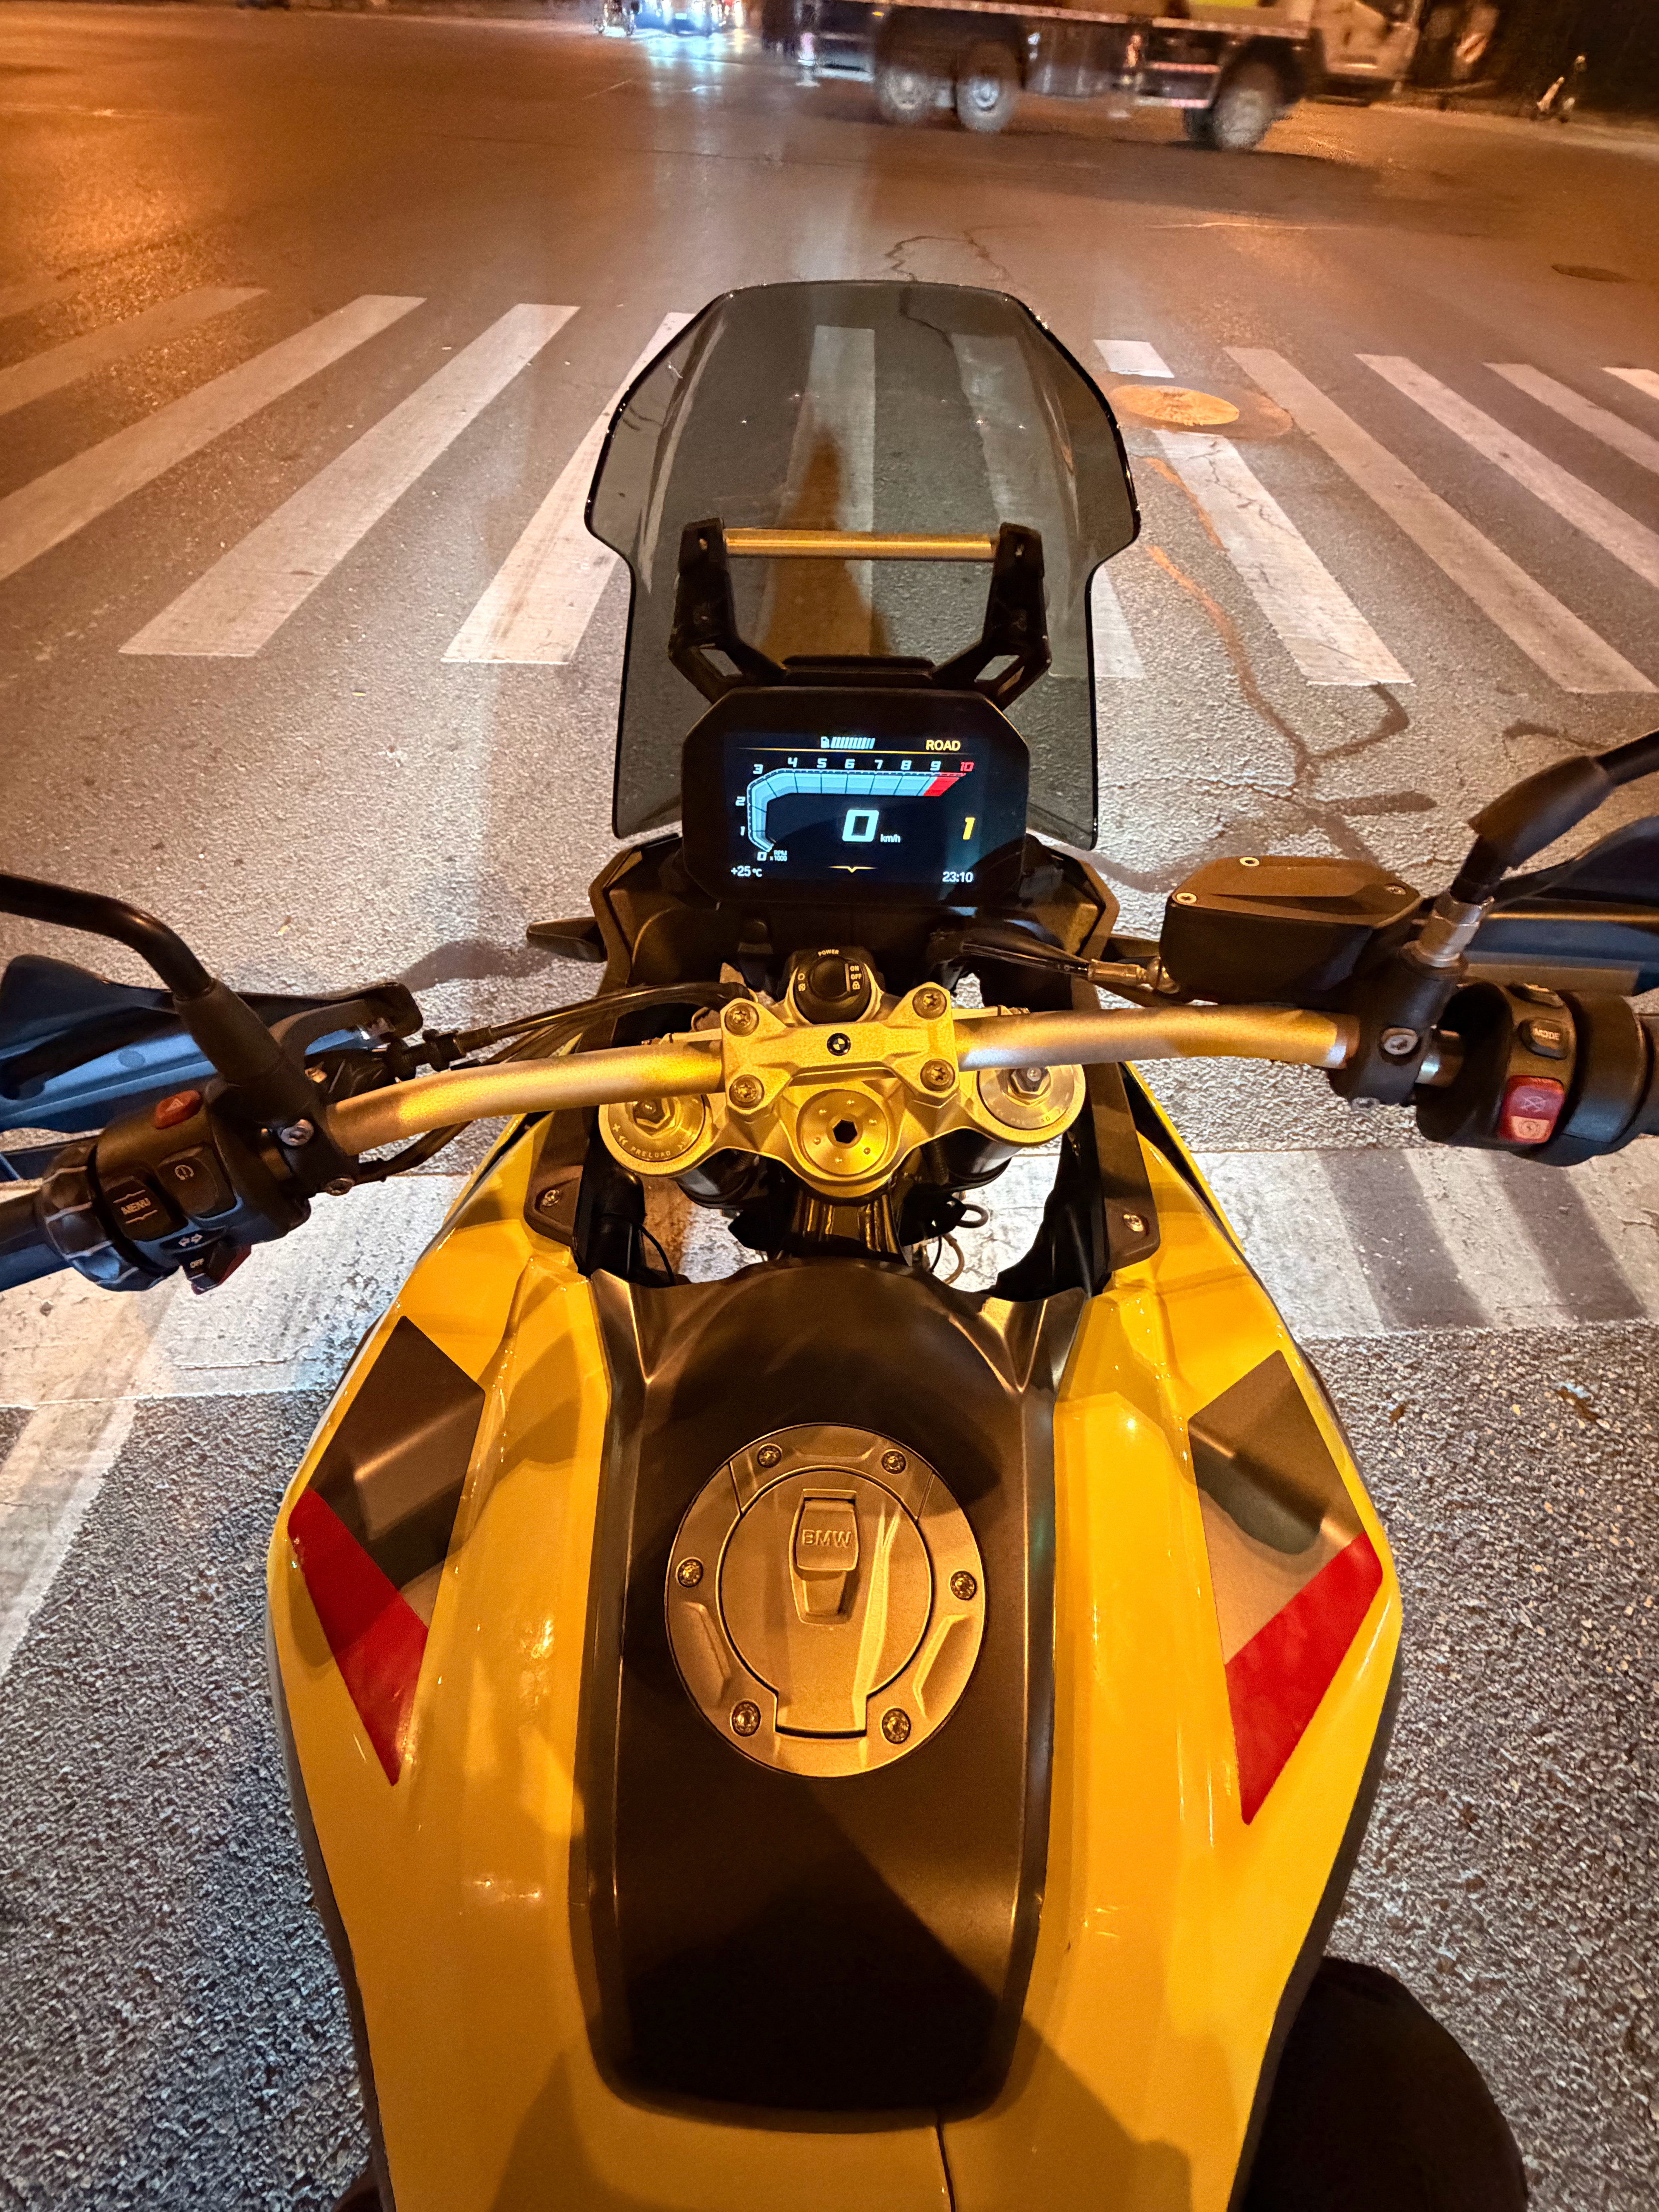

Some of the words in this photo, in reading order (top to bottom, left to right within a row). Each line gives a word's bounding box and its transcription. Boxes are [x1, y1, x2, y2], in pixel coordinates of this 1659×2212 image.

[926, 740, 961, 751] ROAD
[753, 764, 763, 774] 3
[787, 757, 798, 768] 4
[817, 758, 827, 768] 5
[845, 759, 855, 769] 6
[874, 759, 883, 770] 7
[900, 760, 912, 770] 8
[930, 761, 941, 771] 9
[960, 761, 974, 772] 10
[735, 796, 745, 806] 2
[740, 826, 745, 836] 1
[842, 809, 879, 842] 0
[880, 834, 901, 843] km/h
[963, 817, 975, 840] 1
[757, 852, 767, 861] 0
[942, 871, 974, 883] 23:10
[1533, 1027, 1560, 1041] MODE
[630, 1146, 671, 1158] PRELOAD
[120, 1197, 151, 1215] MENU
[190, 1258, 205, 1268] OFF
[802, 1529, 852, 1548] BMW
